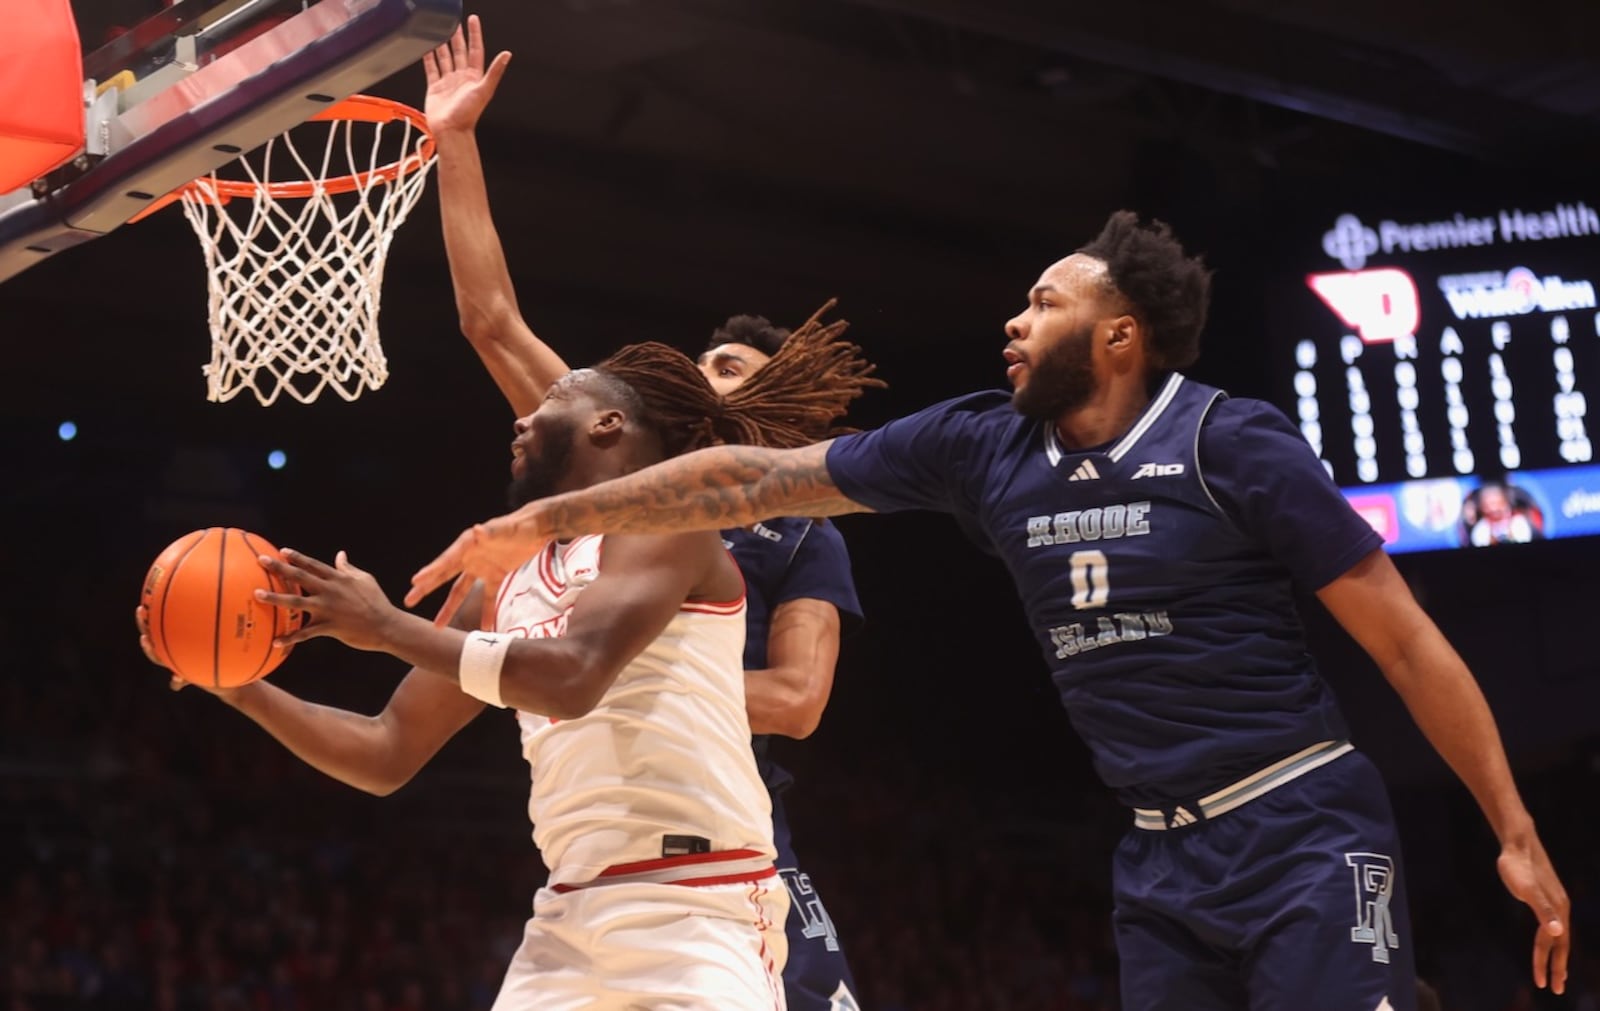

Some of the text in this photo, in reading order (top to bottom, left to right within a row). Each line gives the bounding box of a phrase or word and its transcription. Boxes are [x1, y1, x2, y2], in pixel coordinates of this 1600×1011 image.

[1379, 201, 1600, 253] Premier Health
[1130, 463, 1184, 480] A10
[1027, 501, 1151, 547] RHODE
[1069, 550, 1110, 609] 0
[1049, 611, 1173, 659] ISLAND
